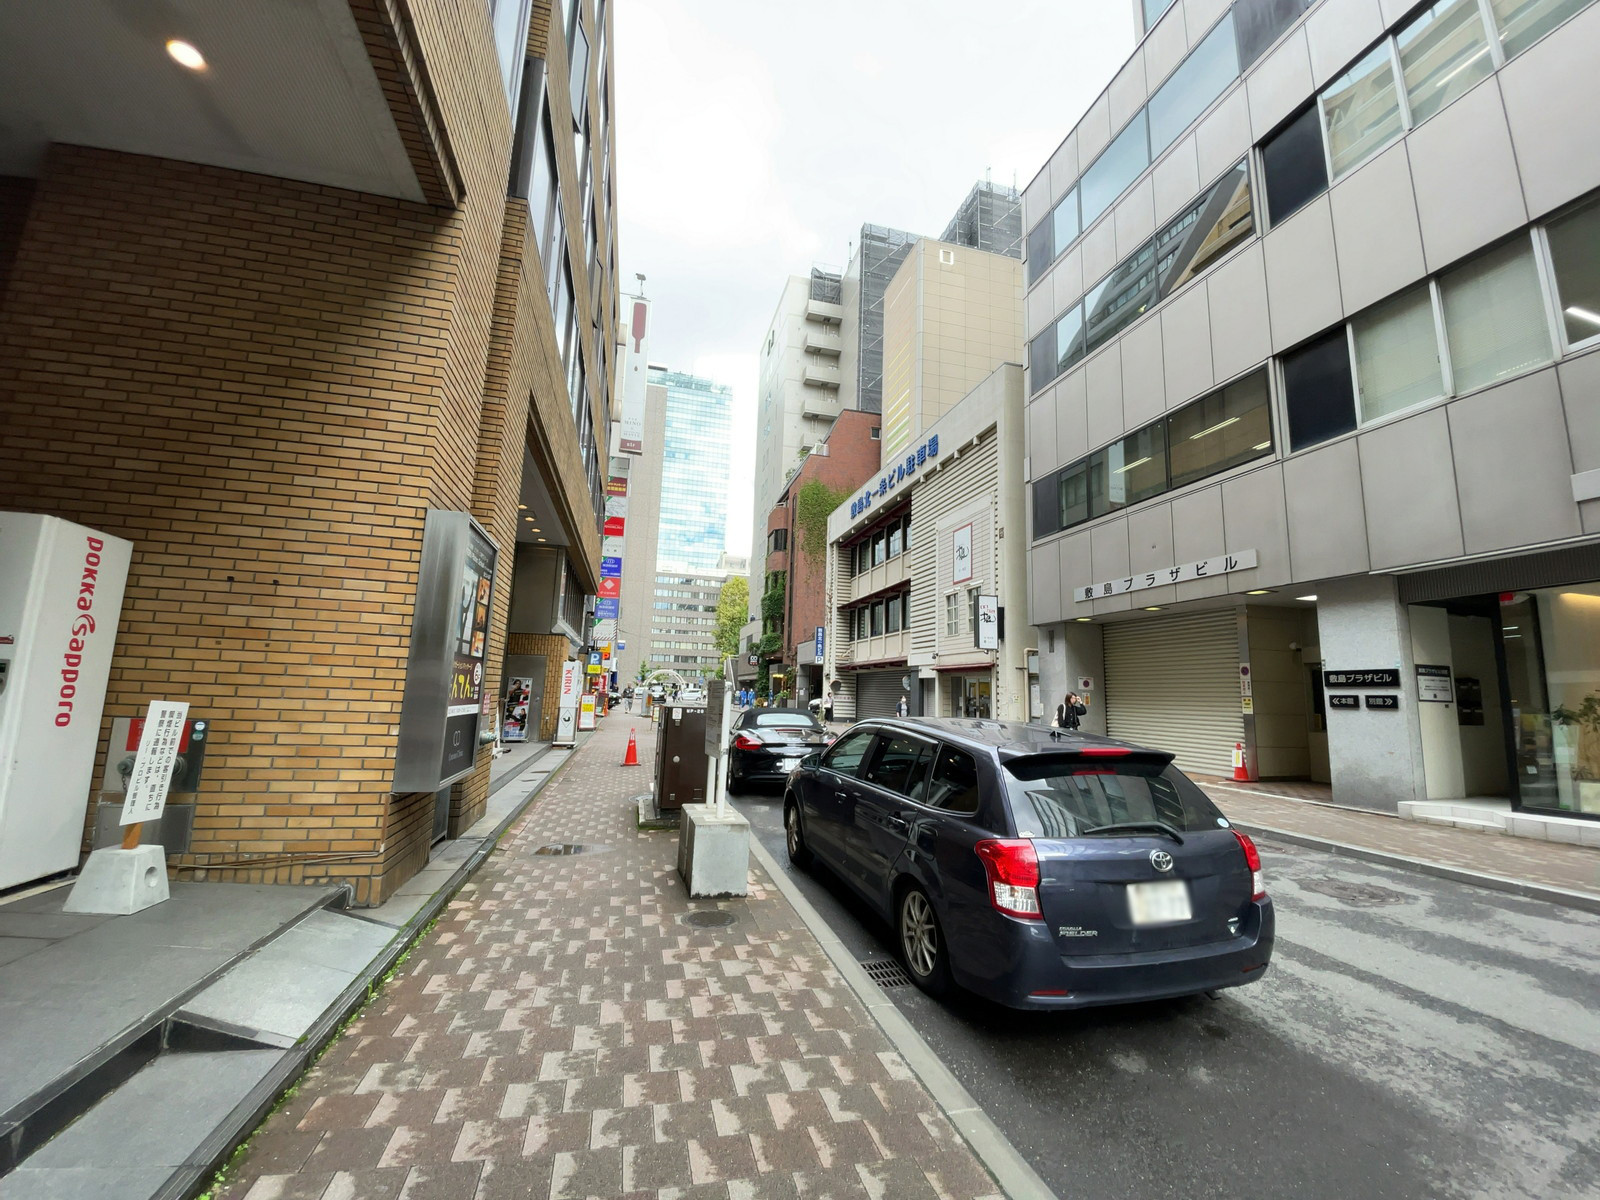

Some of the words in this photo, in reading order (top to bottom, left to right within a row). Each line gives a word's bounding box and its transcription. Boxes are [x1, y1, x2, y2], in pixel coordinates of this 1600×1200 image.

[1084, 555, 1238, 600] 敷島プラザビル
[563, 669, 573, 695] KIRIN
[1329, 673, 1392, 683] 敷島プラザビル
